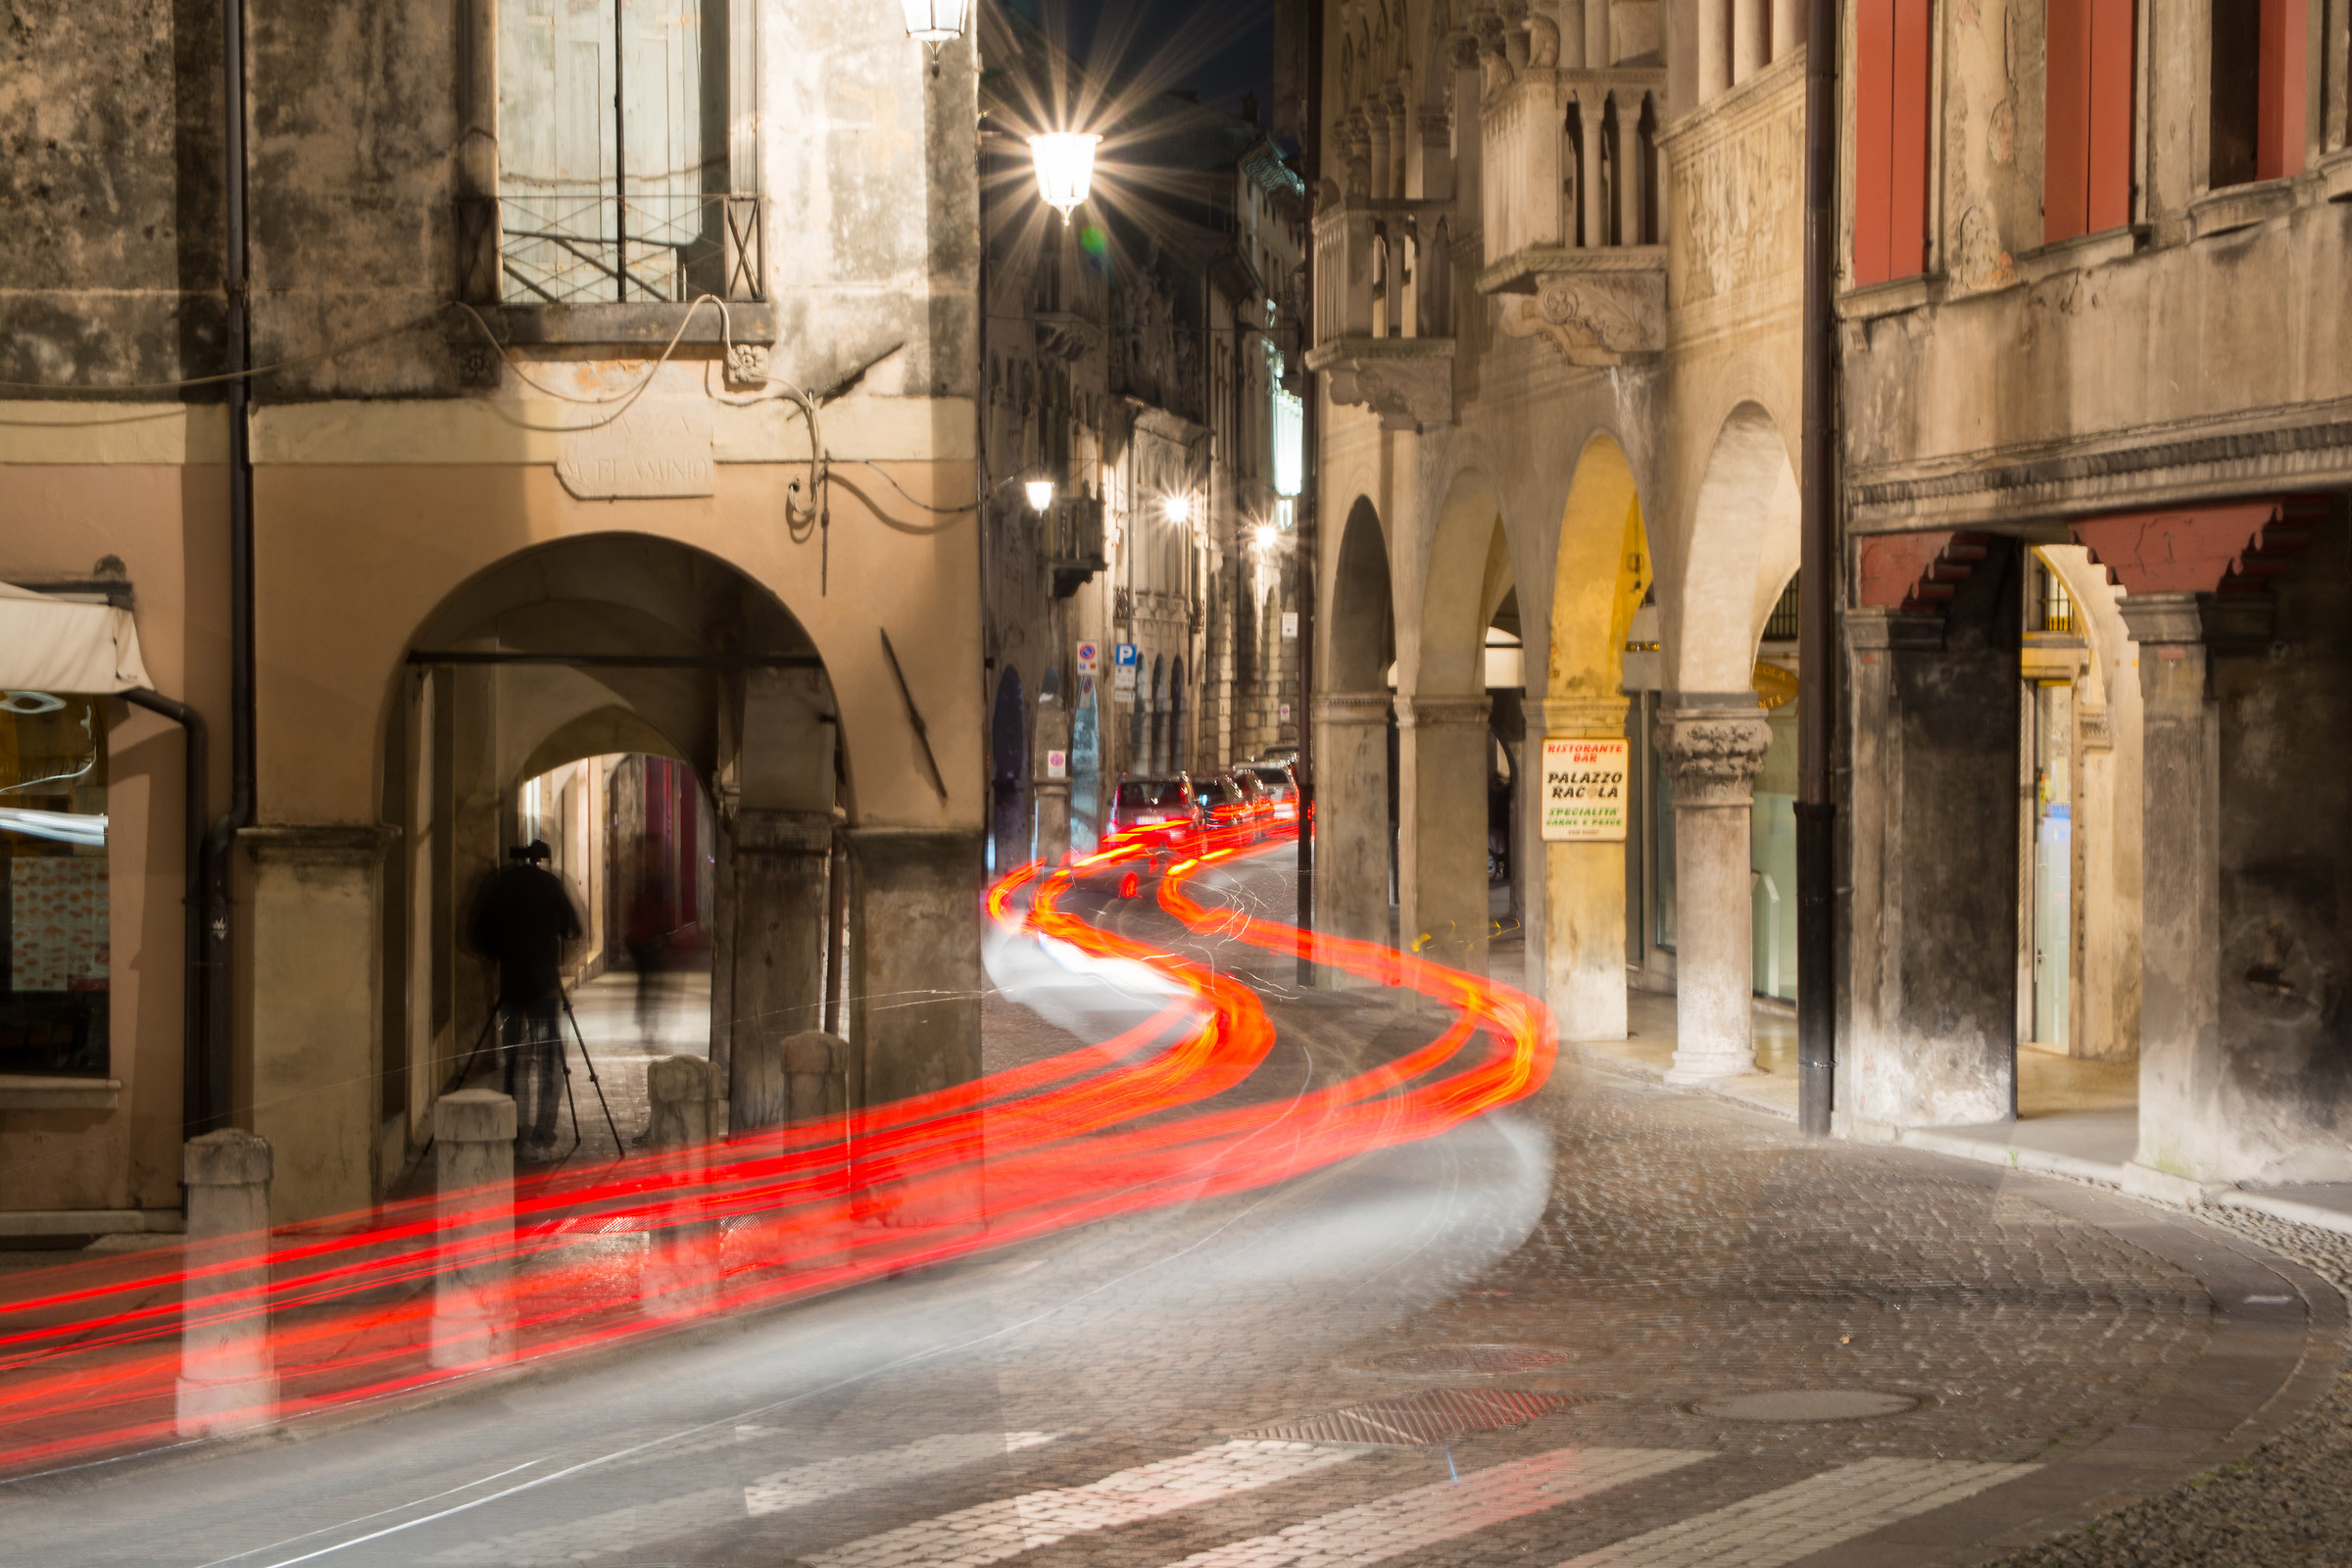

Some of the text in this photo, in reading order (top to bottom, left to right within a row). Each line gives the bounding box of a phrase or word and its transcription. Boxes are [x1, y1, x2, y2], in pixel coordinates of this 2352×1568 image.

[588, 414, 692, 436] PIAZZA
[1547, 744, 1623, 754] RISTORANTE
[1573, 754, 1597, 762] BAR
[1548, 771, 1623, 784] PALAZZO
[1546, 817, 1622, 826] CARNE E PESCE
